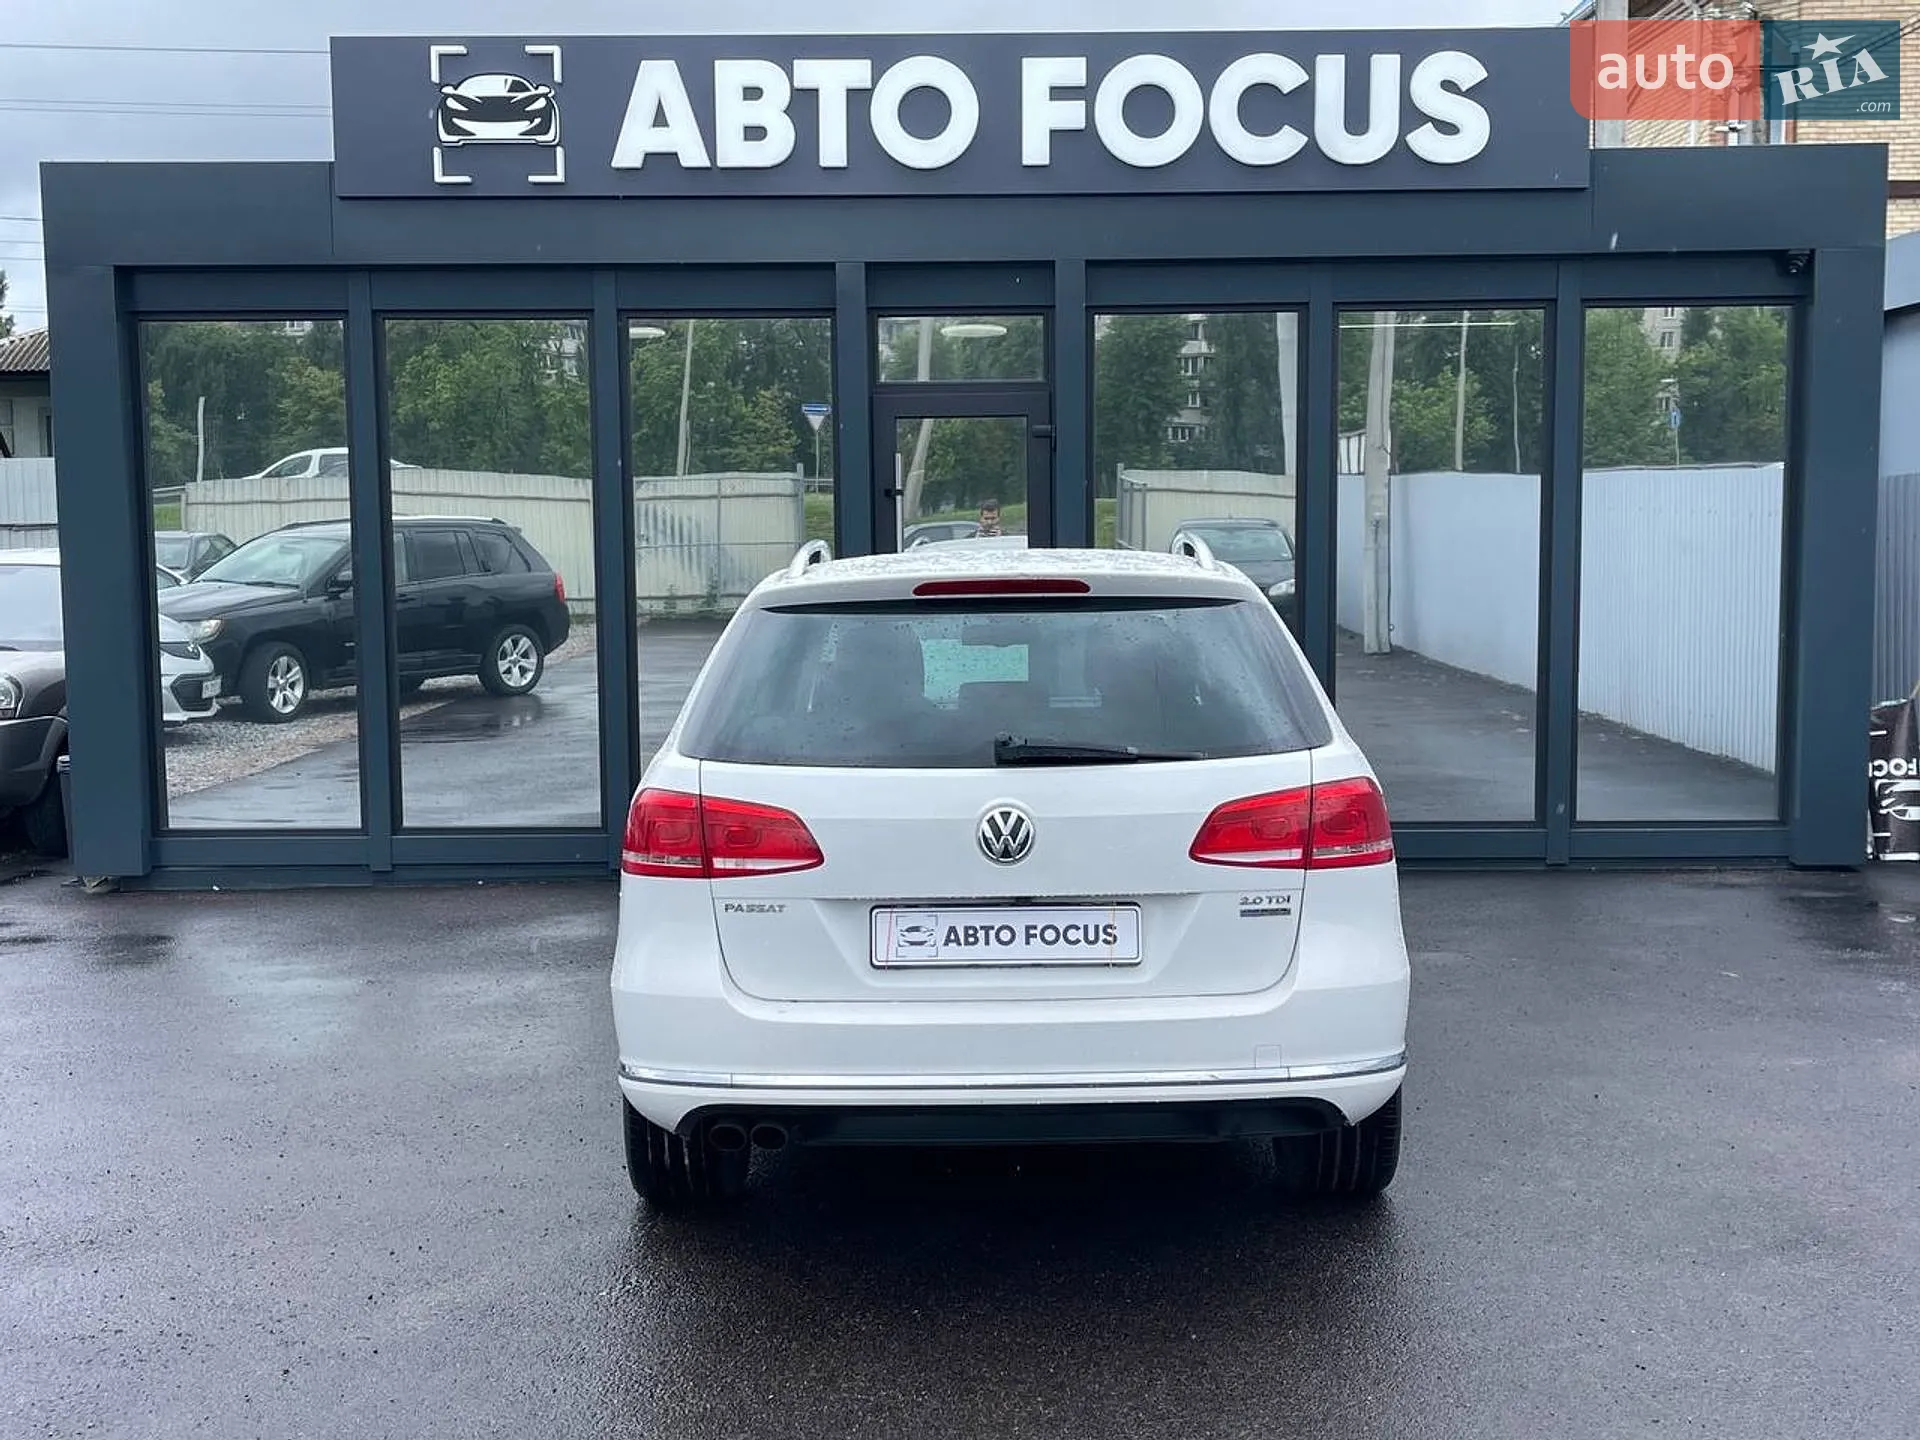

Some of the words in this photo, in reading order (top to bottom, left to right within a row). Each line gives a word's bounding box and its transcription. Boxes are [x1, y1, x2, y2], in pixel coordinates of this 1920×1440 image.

[610, 55, 980, 169] АВТО
[1021, 50, 1491, 167] FOCUS
[1265, 894, 1291, 905] TDI
[724, 903, 786, 914] PASSAT
[942, 924, 1017, 947] АВТО
[1024, 924, 1118, 946] FOCUS
